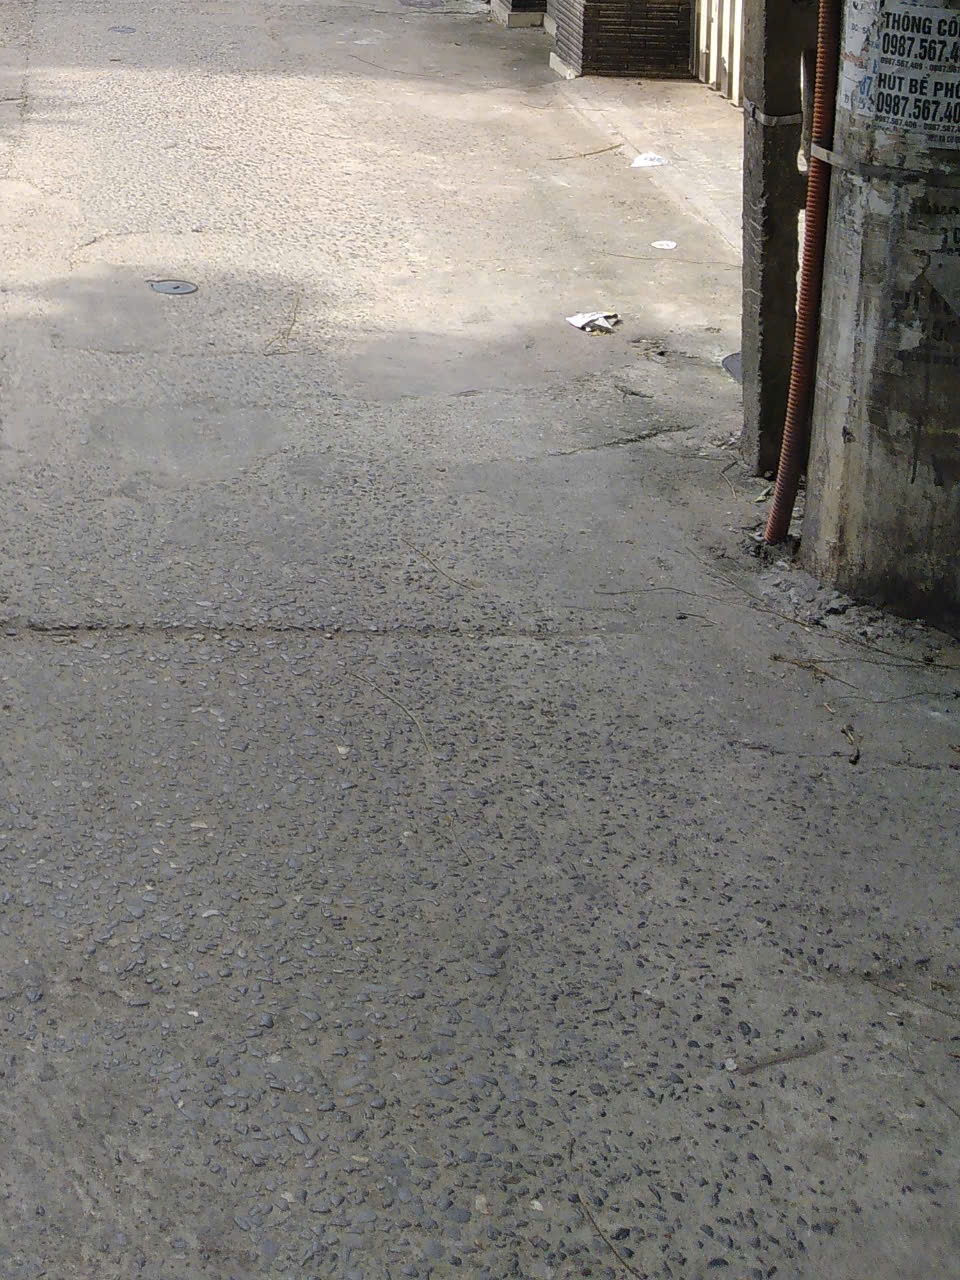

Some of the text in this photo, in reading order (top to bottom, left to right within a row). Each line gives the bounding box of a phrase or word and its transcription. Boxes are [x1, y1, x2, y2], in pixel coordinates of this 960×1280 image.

[885, 11, 932, 35] THÔNG
[882, 33, 960, 64] 0987.567.4
[878, 72, 905, 93] HÚT
[876, 91, 960, 124] 0987.567.40
